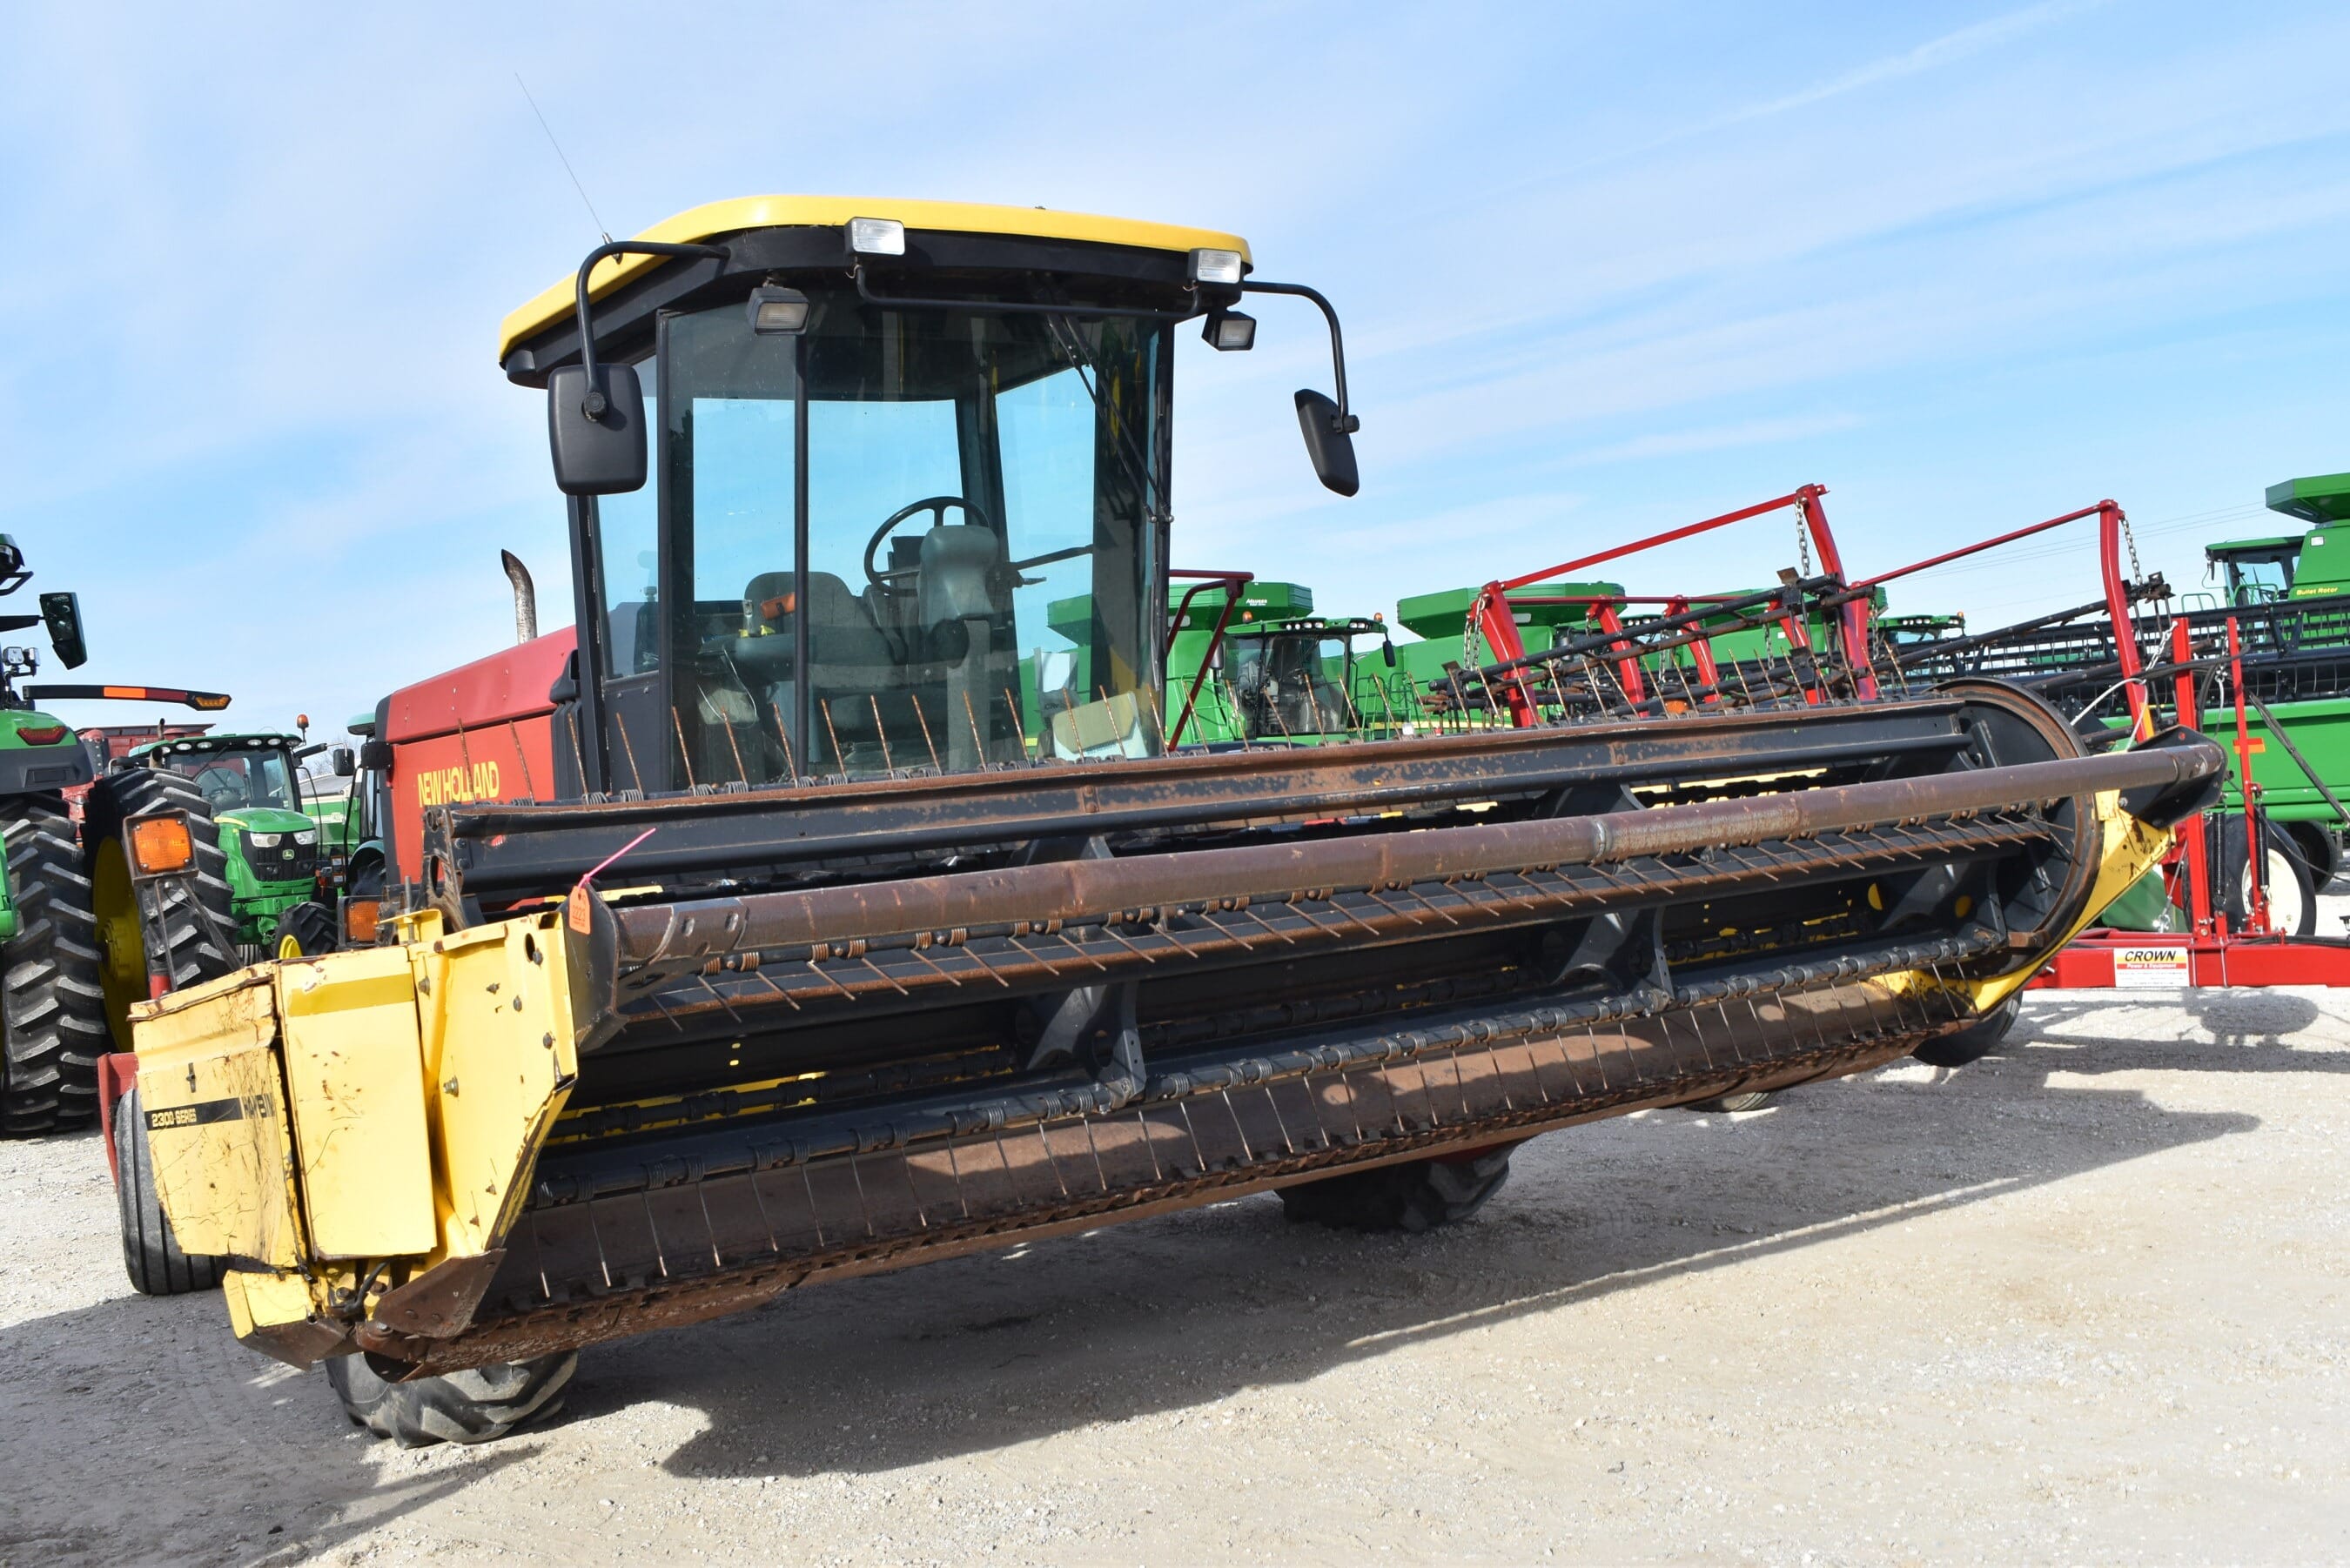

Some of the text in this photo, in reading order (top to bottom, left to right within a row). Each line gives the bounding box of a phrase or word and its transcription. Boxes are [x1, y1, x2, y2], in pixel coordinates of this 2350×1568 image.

[417, 761, 500, 807] NEW HOLLAND
[2125, 950, 2177, 962] CROWN
